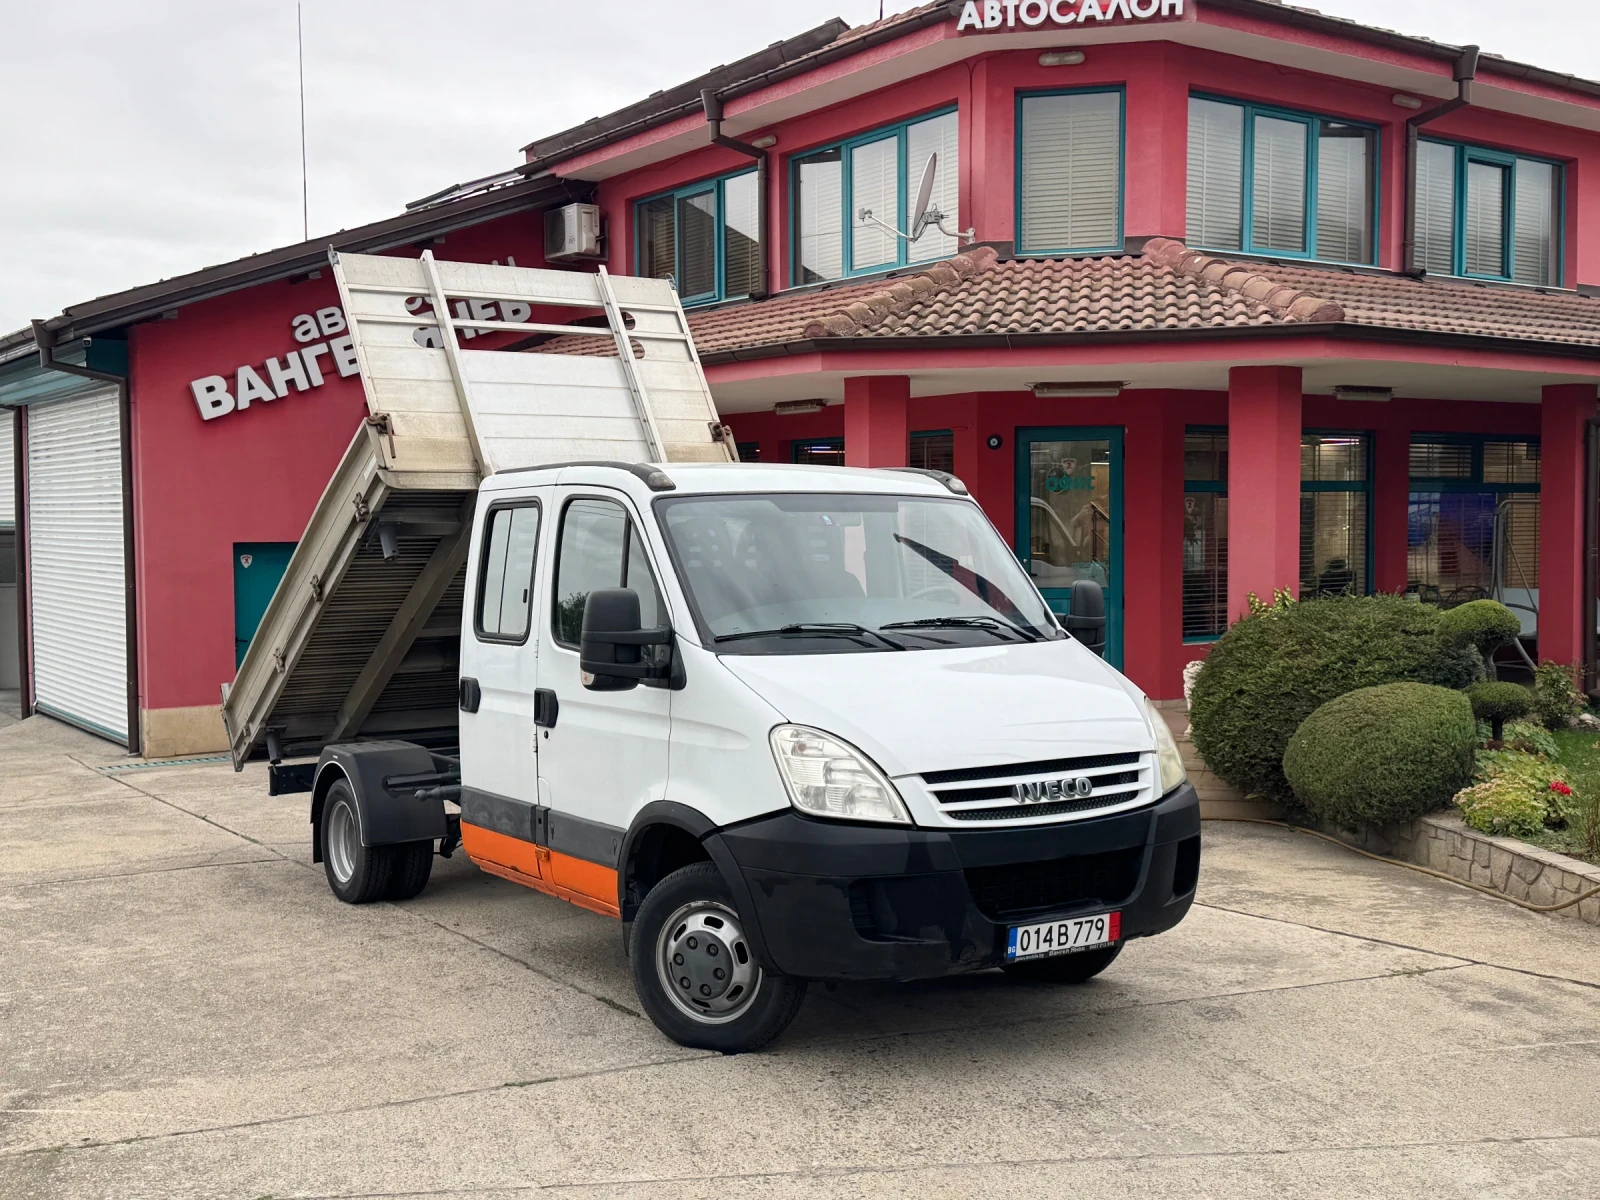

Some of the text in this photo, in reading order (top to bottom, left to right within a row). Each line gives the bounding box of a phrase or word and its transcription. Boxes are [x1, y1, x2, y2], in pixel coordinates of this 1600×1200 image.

[956, 0, 1184, 31] АВТОСАЛОН
[190, 335, 360, 421] ВАНГЕ
[1012, 777, 1093, 804] IVECO
[1007, 945, 1016, 954] BG
